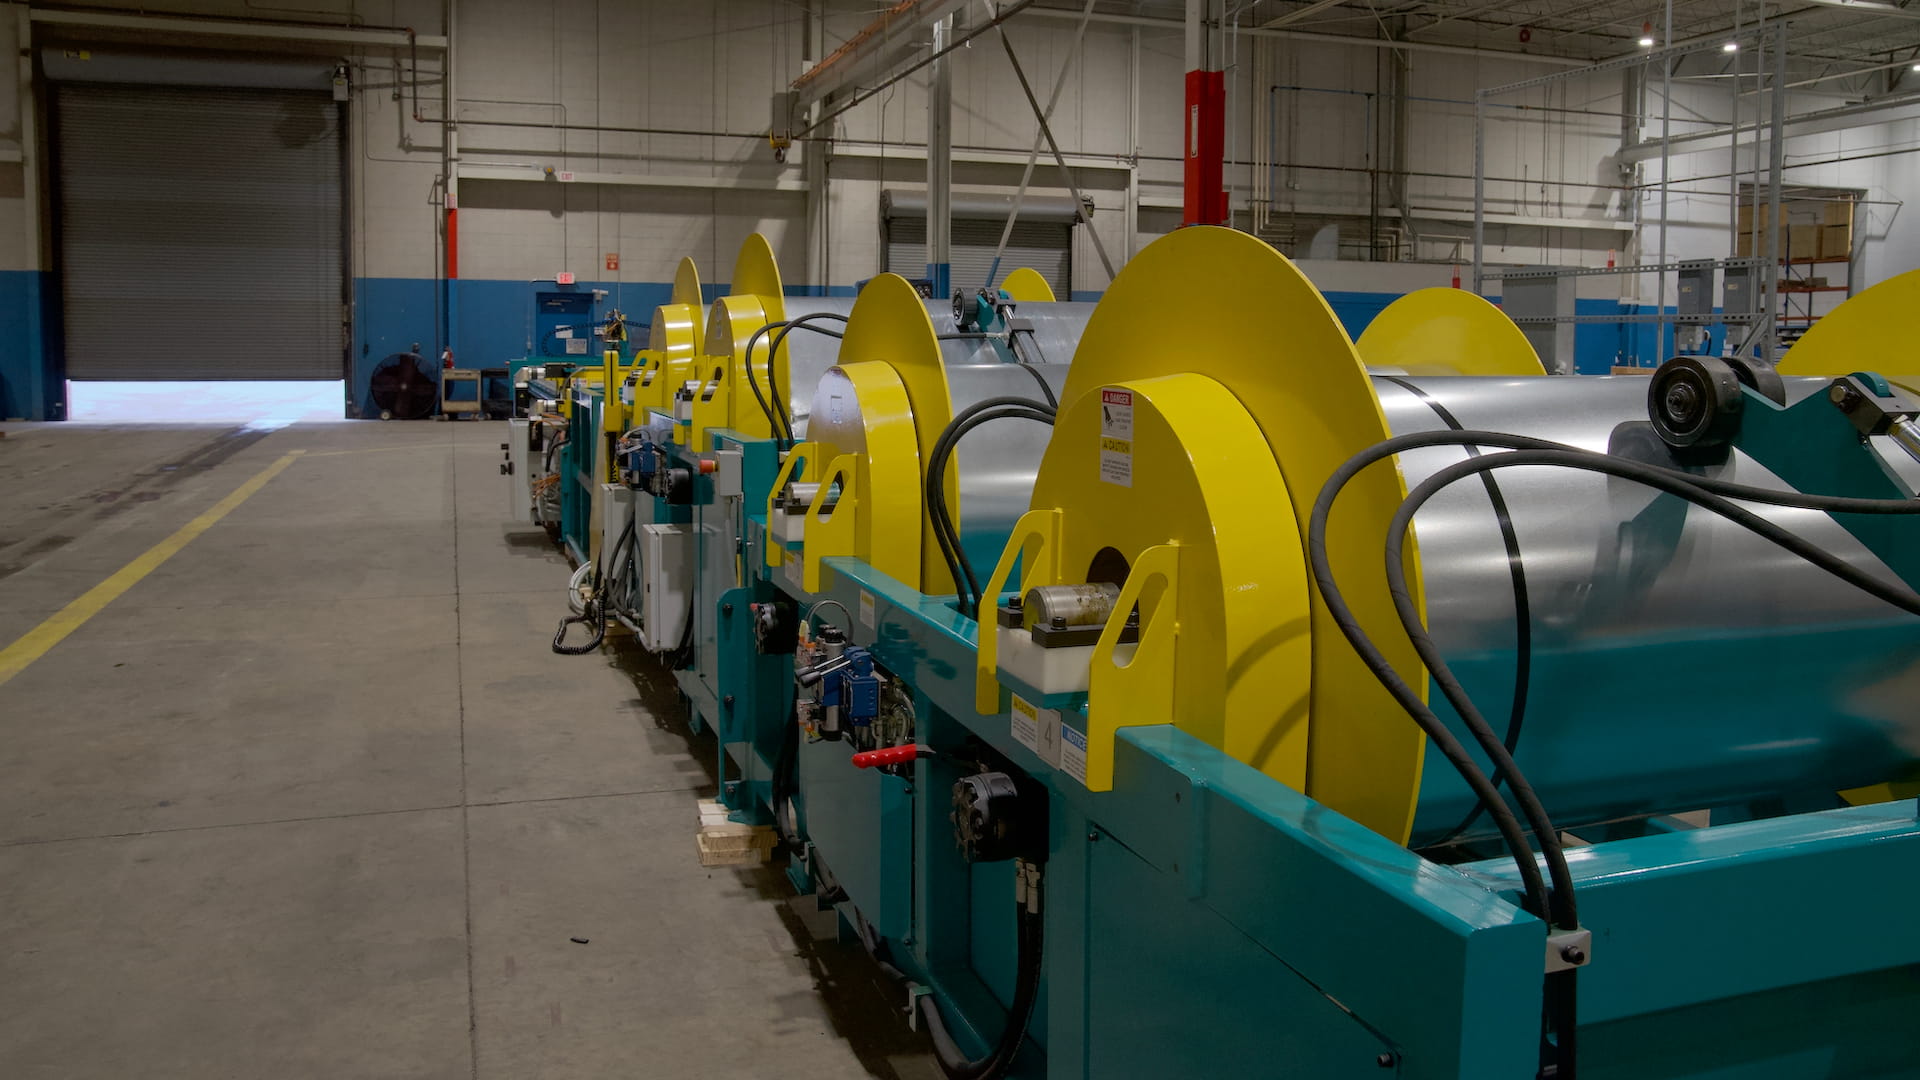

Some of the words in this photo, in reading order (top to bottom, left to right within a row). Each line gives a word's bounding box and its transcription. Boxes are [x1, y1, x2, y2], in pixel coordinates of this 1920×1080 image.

[561, 172, 573, 180] EXIT
[1110, 392, 1129, 405] DANGER
[1109, 440, 1129, 453] CAUTION
[1044, 720, 1053, 750] 4
[1067, 728, 1087, 751] NOTICE
